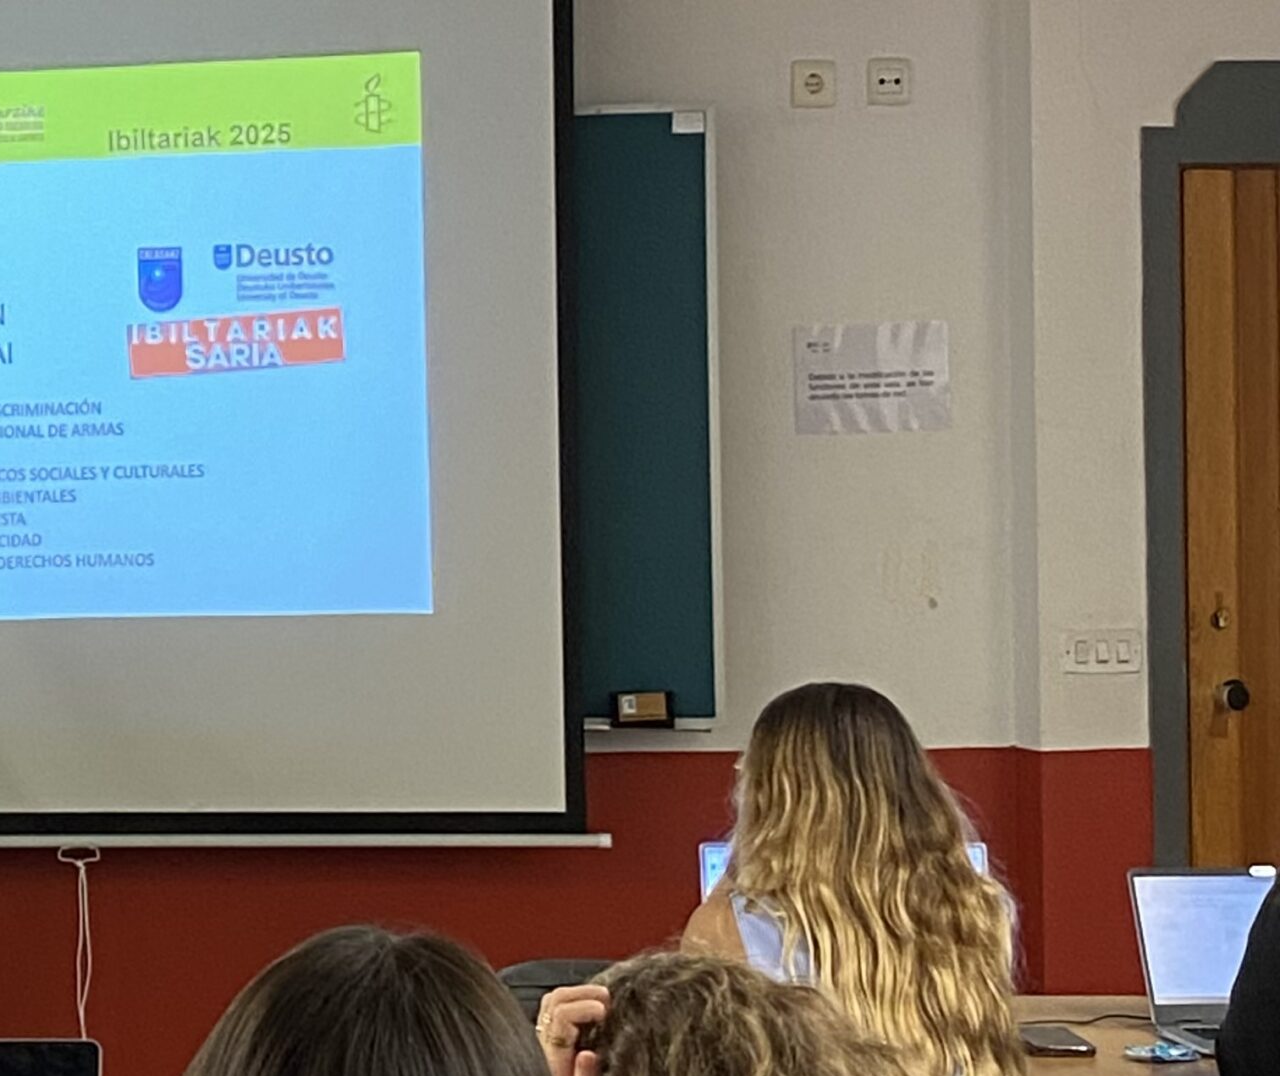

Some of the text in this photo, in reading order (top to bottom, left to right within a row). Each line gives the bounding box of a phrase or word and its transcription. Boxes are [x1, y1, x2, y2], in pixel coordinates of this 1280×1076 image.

[108, 123, 291, 152] Ibiltariak 2025
[236, 242, 334, 268] Deusto
[131, 315, 339, 345] IBILTARIAK
[185, 342, 283, 370] SARIA
[48, 424, 67, 438] DE
[71, 422, 124, 437] ARMAS
[30, 466, 97, 481] SOCIALES
[100, 466, 109, 480] Y
[113, 464, 205, 479] CULTURALES
[76, 553, 155, 568] HUMANOS
